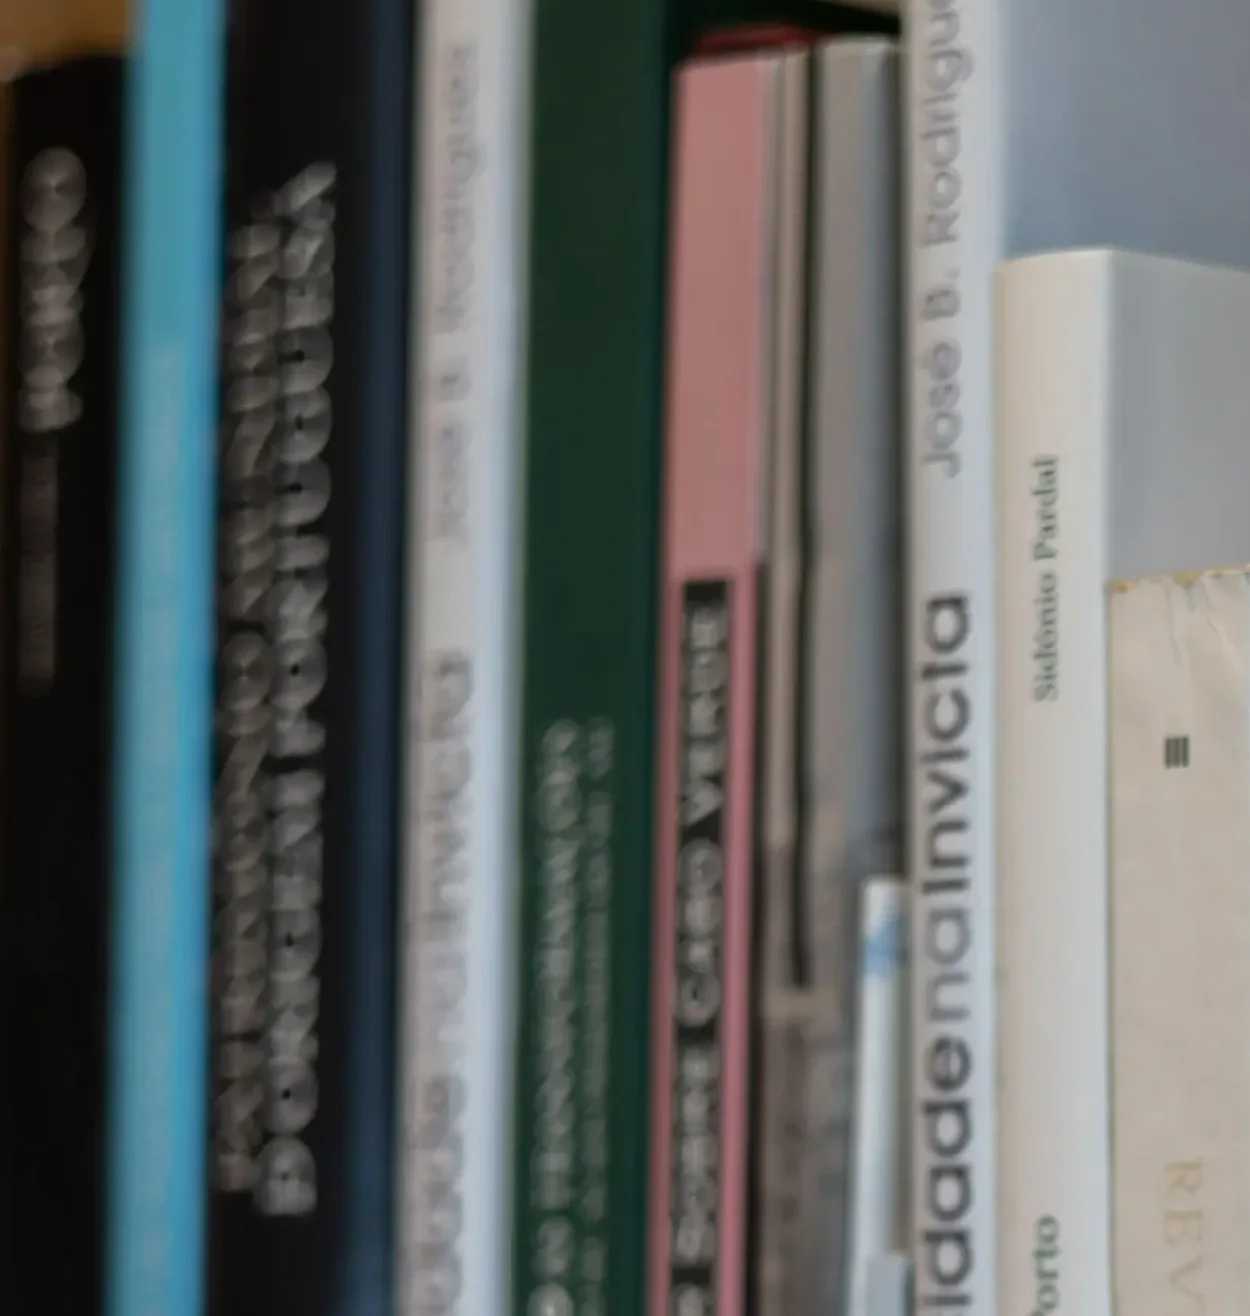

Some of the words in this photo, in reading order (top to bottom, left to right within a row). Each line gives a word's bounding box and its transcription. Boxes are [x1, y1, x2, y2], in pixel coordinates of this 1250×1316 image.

[920, 0, 973, 248] Rodrigu
[918, 339, 962, 478] José
[1031, 454, 1060, 562] Pardal
[1032, 572, 1060, 704] Sidónio
